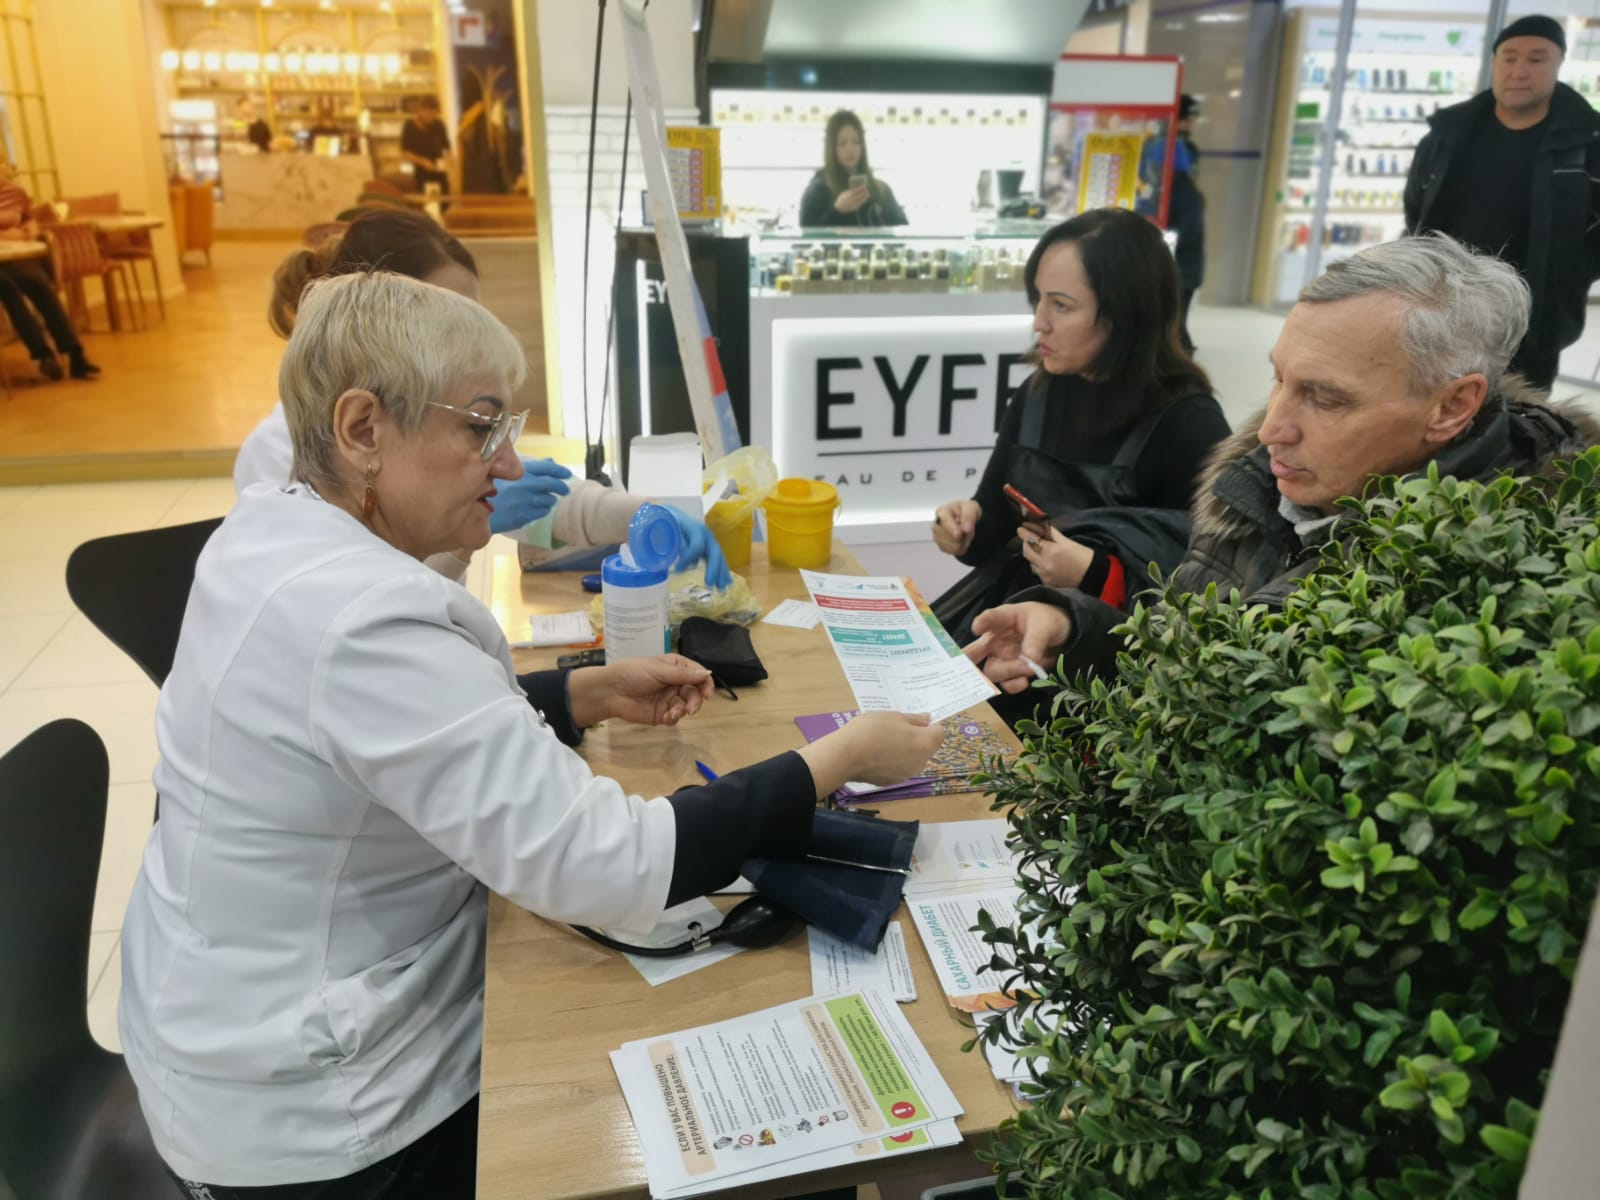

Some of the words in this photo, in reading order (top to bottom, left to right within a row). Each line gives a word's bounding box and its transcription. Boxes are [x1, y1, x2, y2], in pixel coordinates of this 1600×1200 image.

[902, 470, 937, 483] DE
[919, 905, 948, 938] ДИАБЕТ
[935, 940, 971, 990] САХАРНЫЙ
[655, 1064, 675, 1107] ПОВЫШЕНО
[669, 1108, 682, 1124] ВАС
[680, 1095, 707, 1155] АРТЕРИАЛЬНОЕ
[676, 1131, 691, 1153] ЕСЛИ
